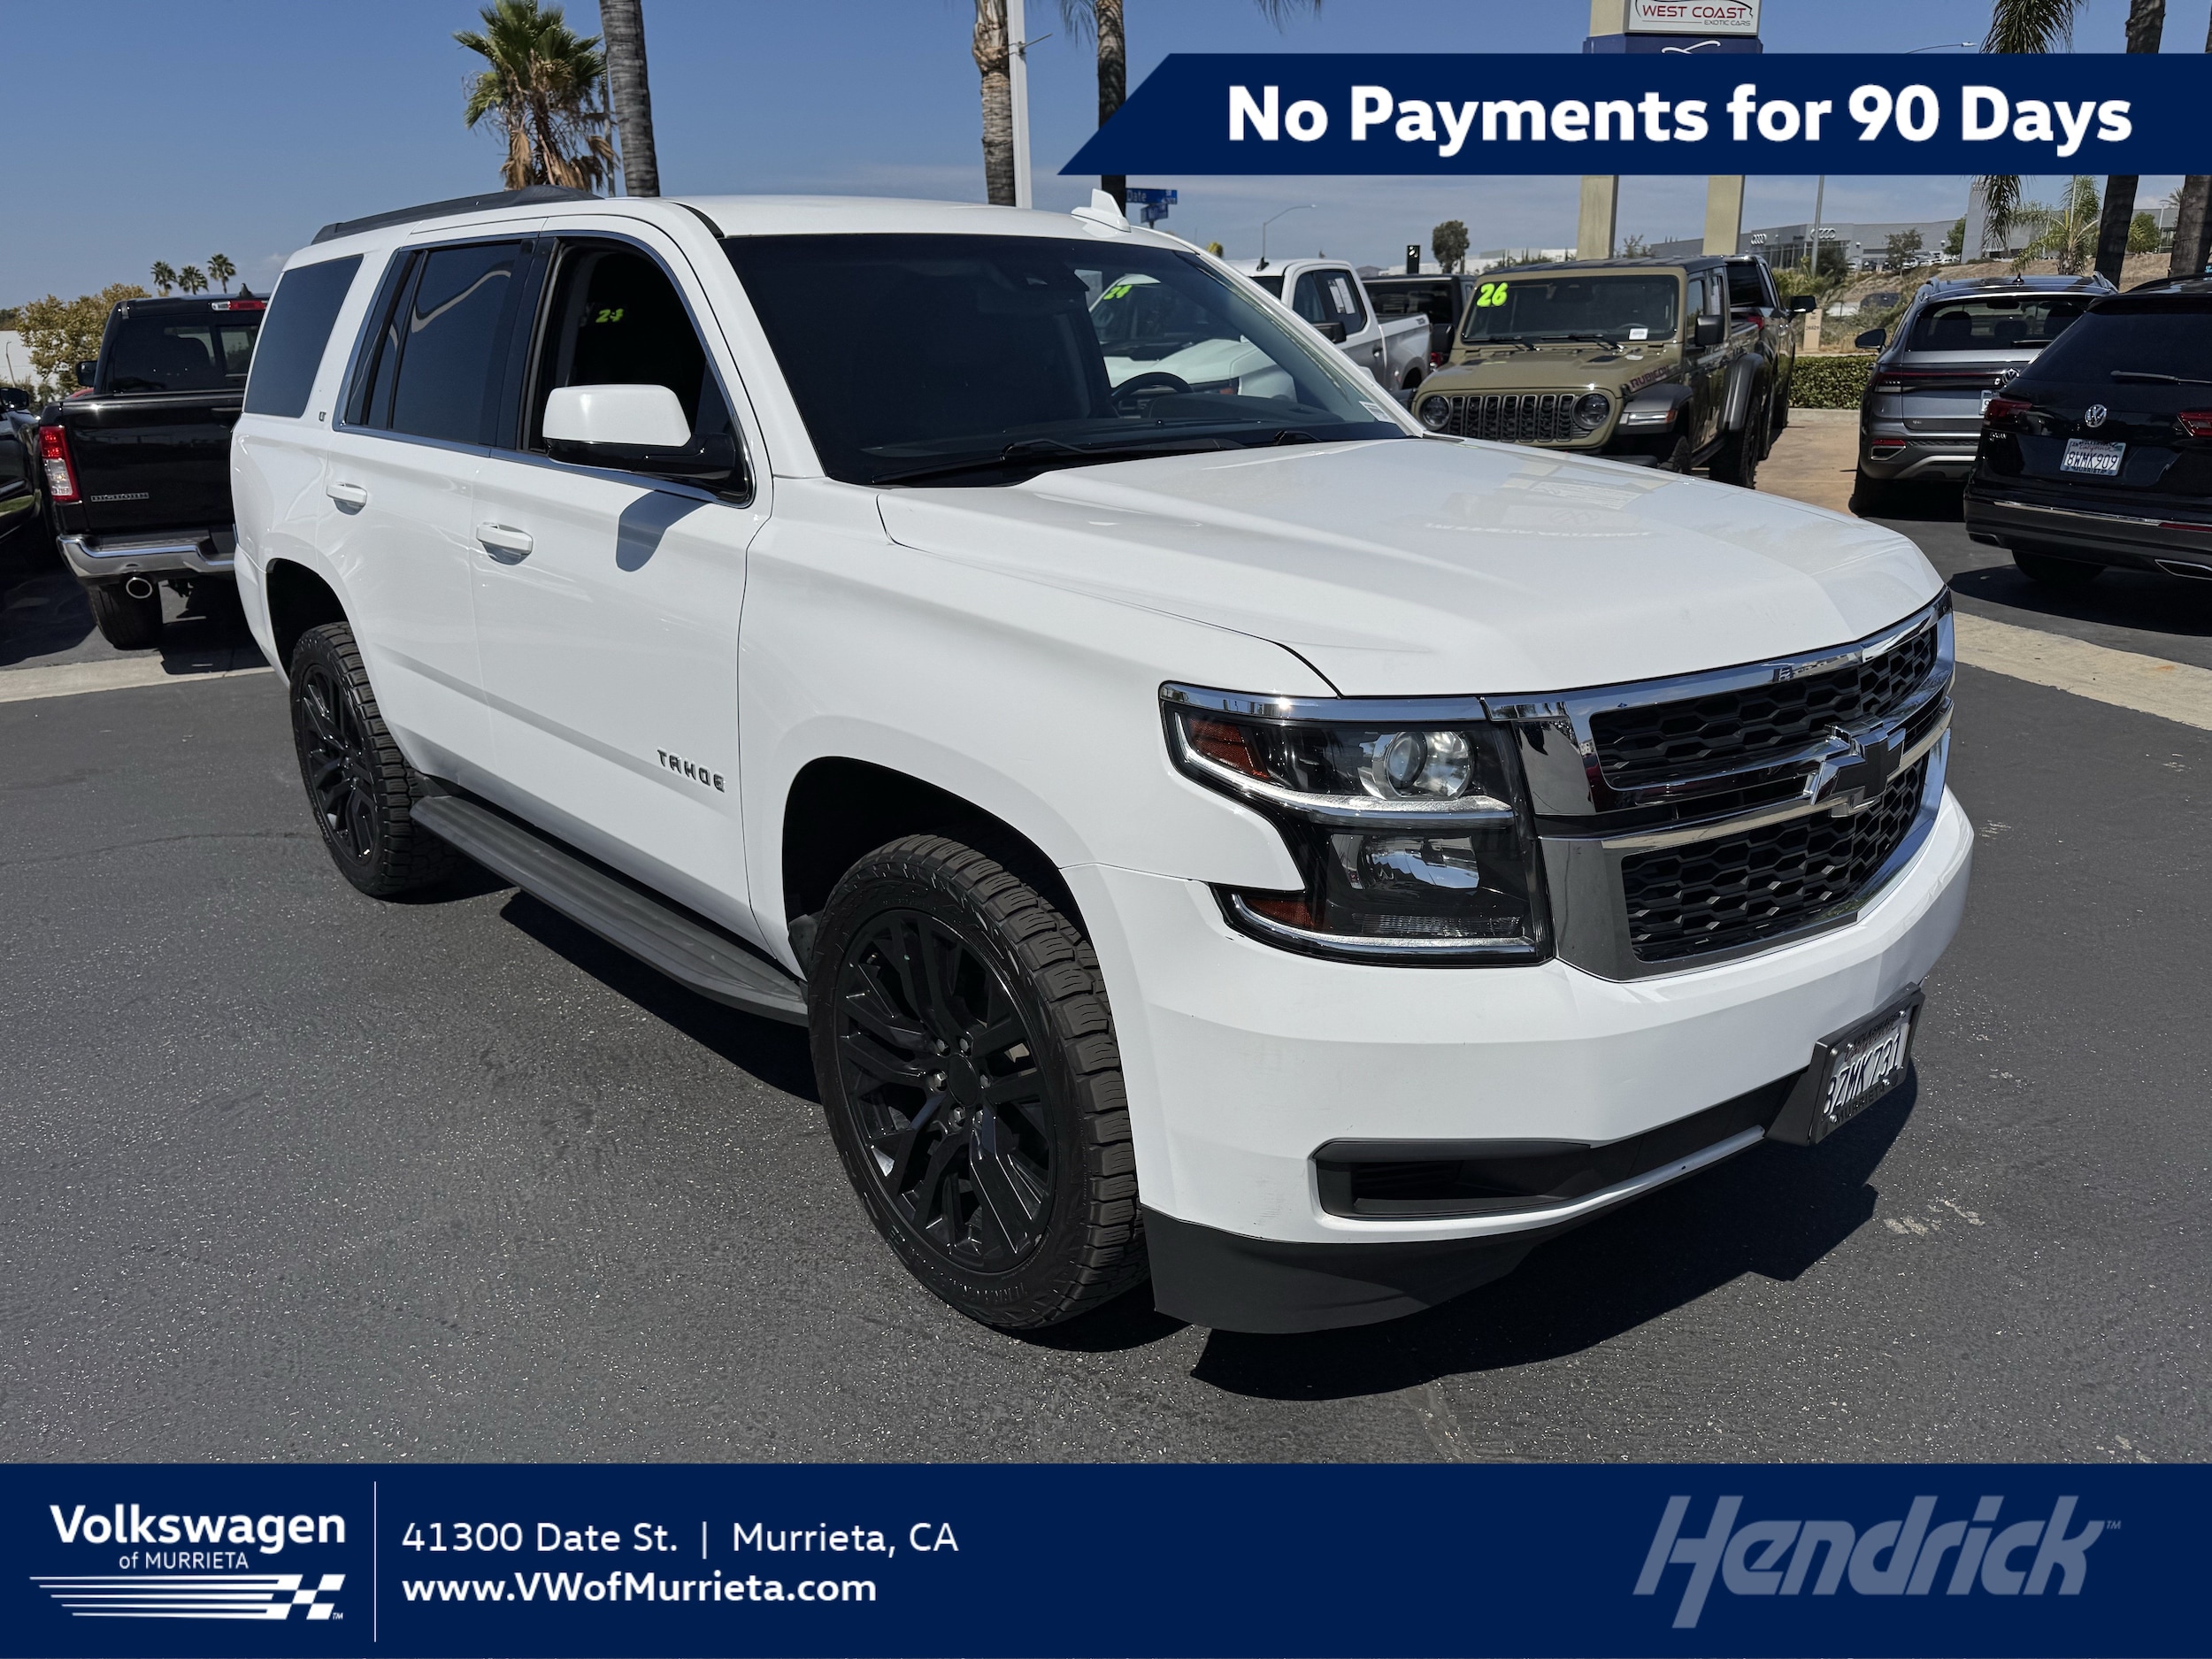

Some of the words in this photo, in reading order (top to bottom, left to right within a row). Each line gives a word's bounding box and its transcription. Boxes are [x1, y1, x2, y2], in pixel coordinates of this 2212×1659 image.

[1642, 4, 1687, 18] WEST
[1692, 6, 1747, 19] COAST
[1126, 189, 1148, 202] Date
[1103, 285, 1133, 300] 24
[1477, 282, 1509, 307] 26
[1629, 365, 1671, 388] RUBICON
[657, 747, 726, 793] TAHOE
